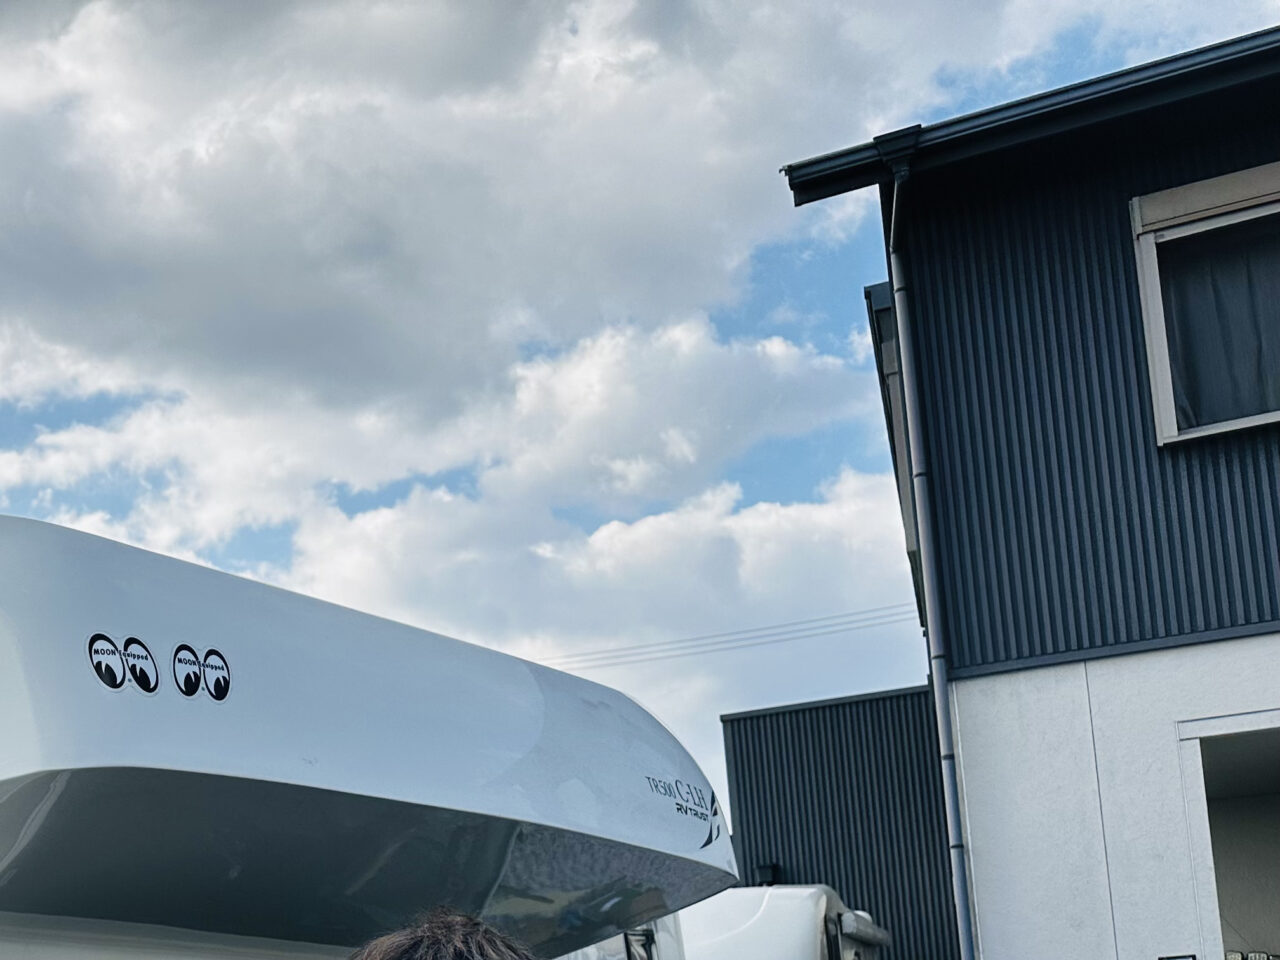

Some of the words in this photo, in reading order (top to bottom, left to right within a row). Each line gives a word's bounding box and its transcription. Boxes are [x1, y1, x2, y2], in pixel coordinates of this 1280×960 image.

[93, 648, 117, 656] MOON
[177, 657, 197, 666] MOON
[645, 776, 676, 799] TR500
[675, 779, 708, 811] C-LH
